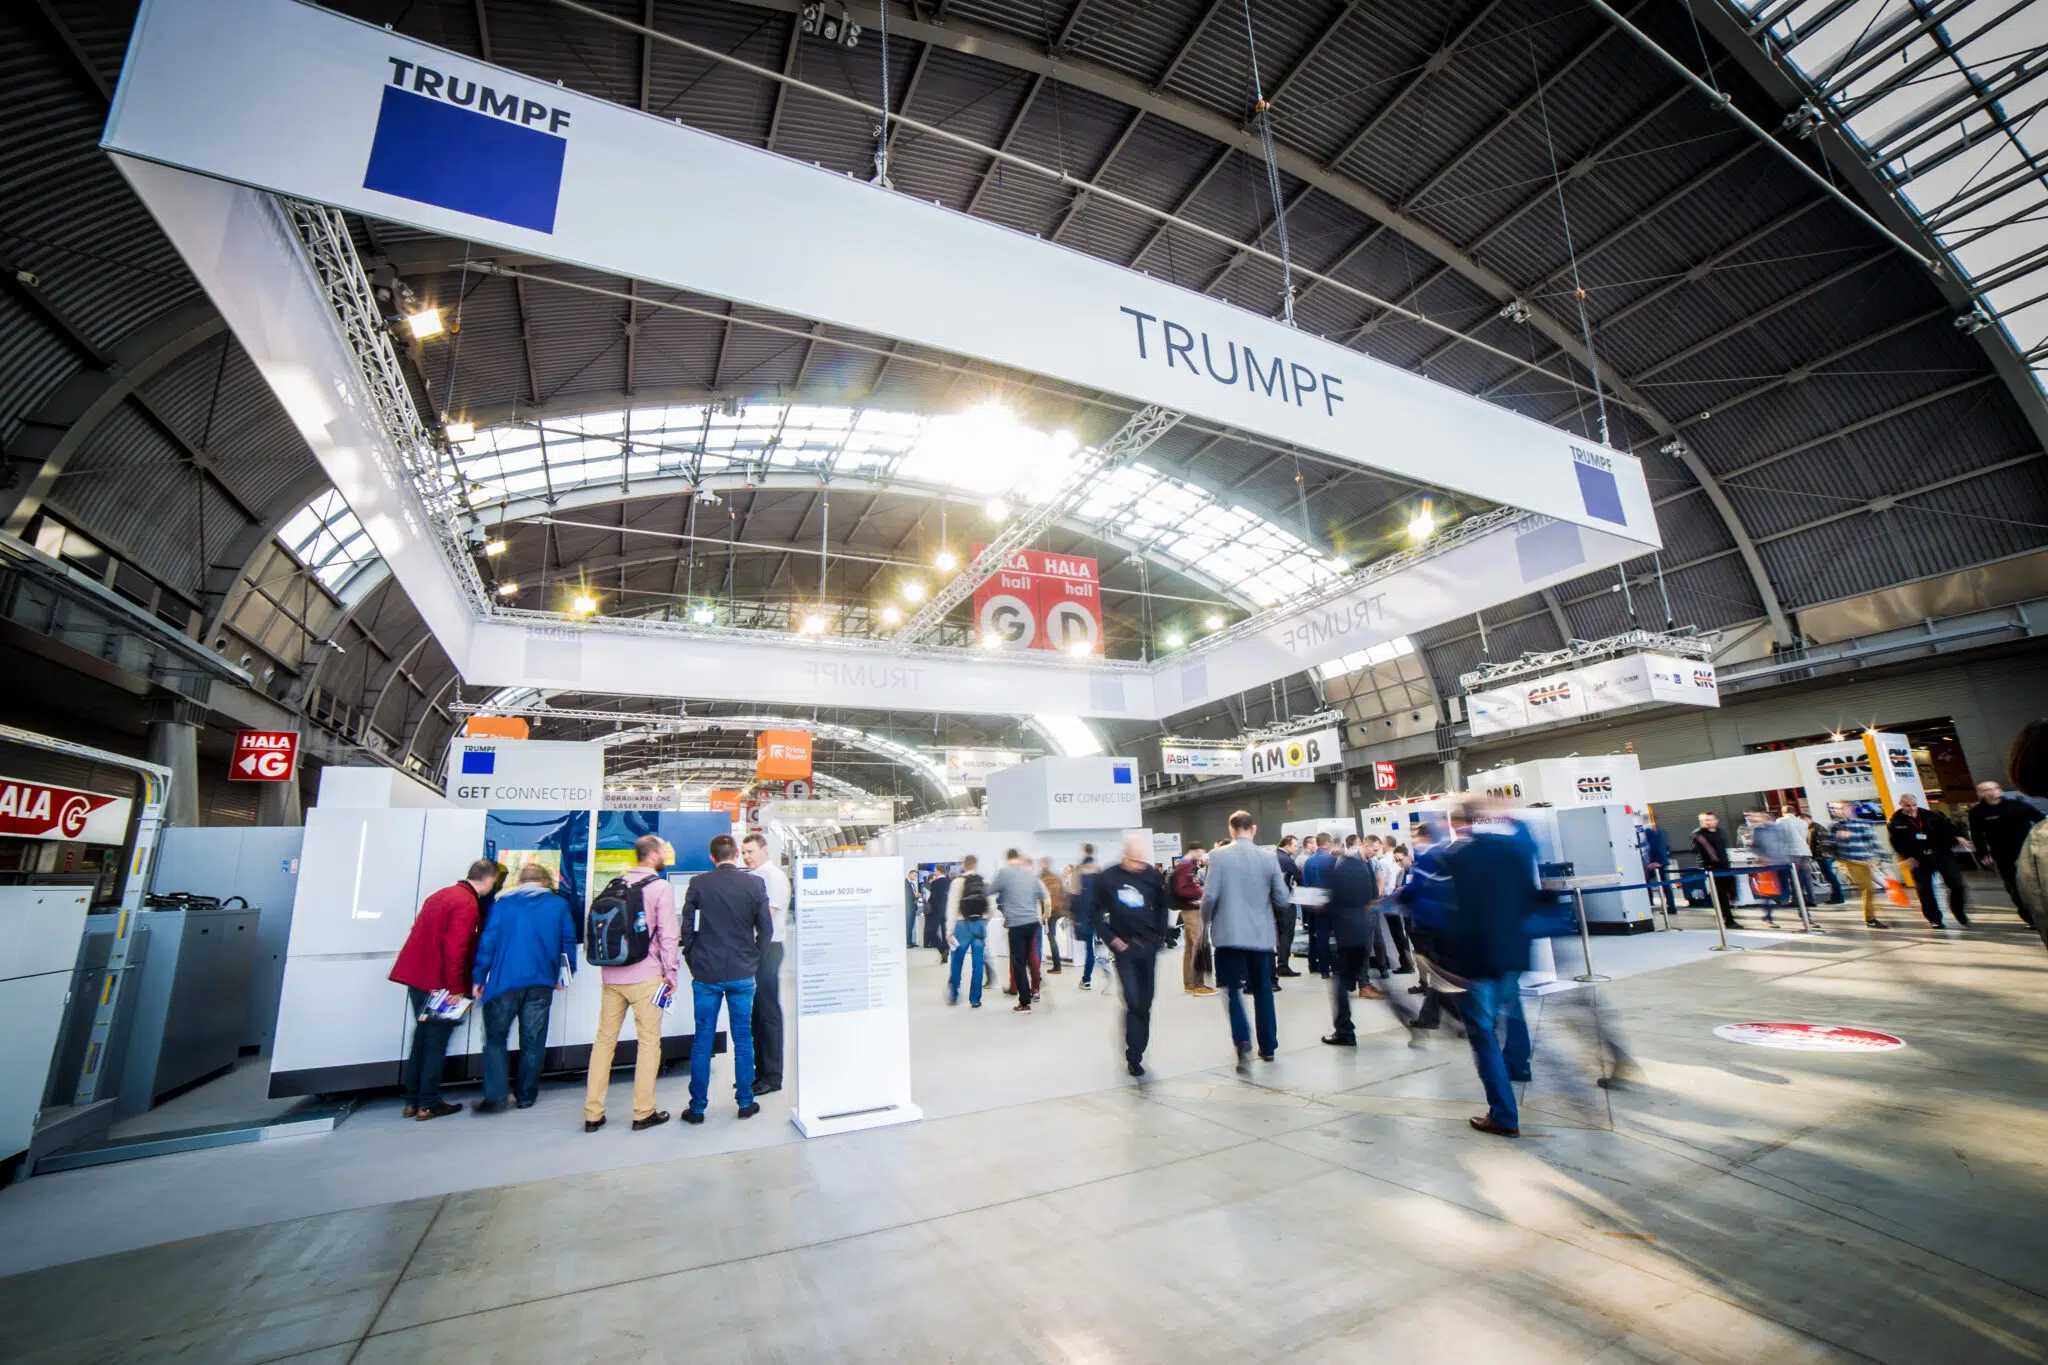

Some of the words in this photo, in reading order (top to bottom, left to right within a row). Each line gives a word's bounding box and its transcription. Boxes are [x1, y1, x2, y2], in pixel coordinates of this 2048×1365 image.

[388, 56, 571, 133] TRUMPF
[1120, 305, 1344, 417] TRUMPF
[1569, 445, 1612, 471] TRUMPF
[1044, 558, 1091, 578] HALA
[1001, 574, 1031, 590] hall
[1065, 581, 1093, 597] hall
[991, 605, 1025, 641] G
[1060, 611, 1089, 645] D
[1528, 681, 1571, 706] CNC
[242, 735, 291, 749] HALA
[258, 752, 288, 777] G
[1168, 754, 1189, 765] ABH
[1252, 739, 1321, 775] AMOB
[1816, 754, 1872, 776] CNC
[794, 784, 803, 798] F
[1379, 774, 1388, 789] D
[1577, 776, 1612, 793] CNC
[1822, 776, 1873, 786] PROJEK
[458, 786, 490, 799] GET
[496, 786, 592, 801] CONNECTED!
[1055, 793, 1073, 803] GET
[1077, 792, 1136, 804] CONNECTED!
[0, 785, 51, 820] ALA
[58, 796, 91, 838] G
